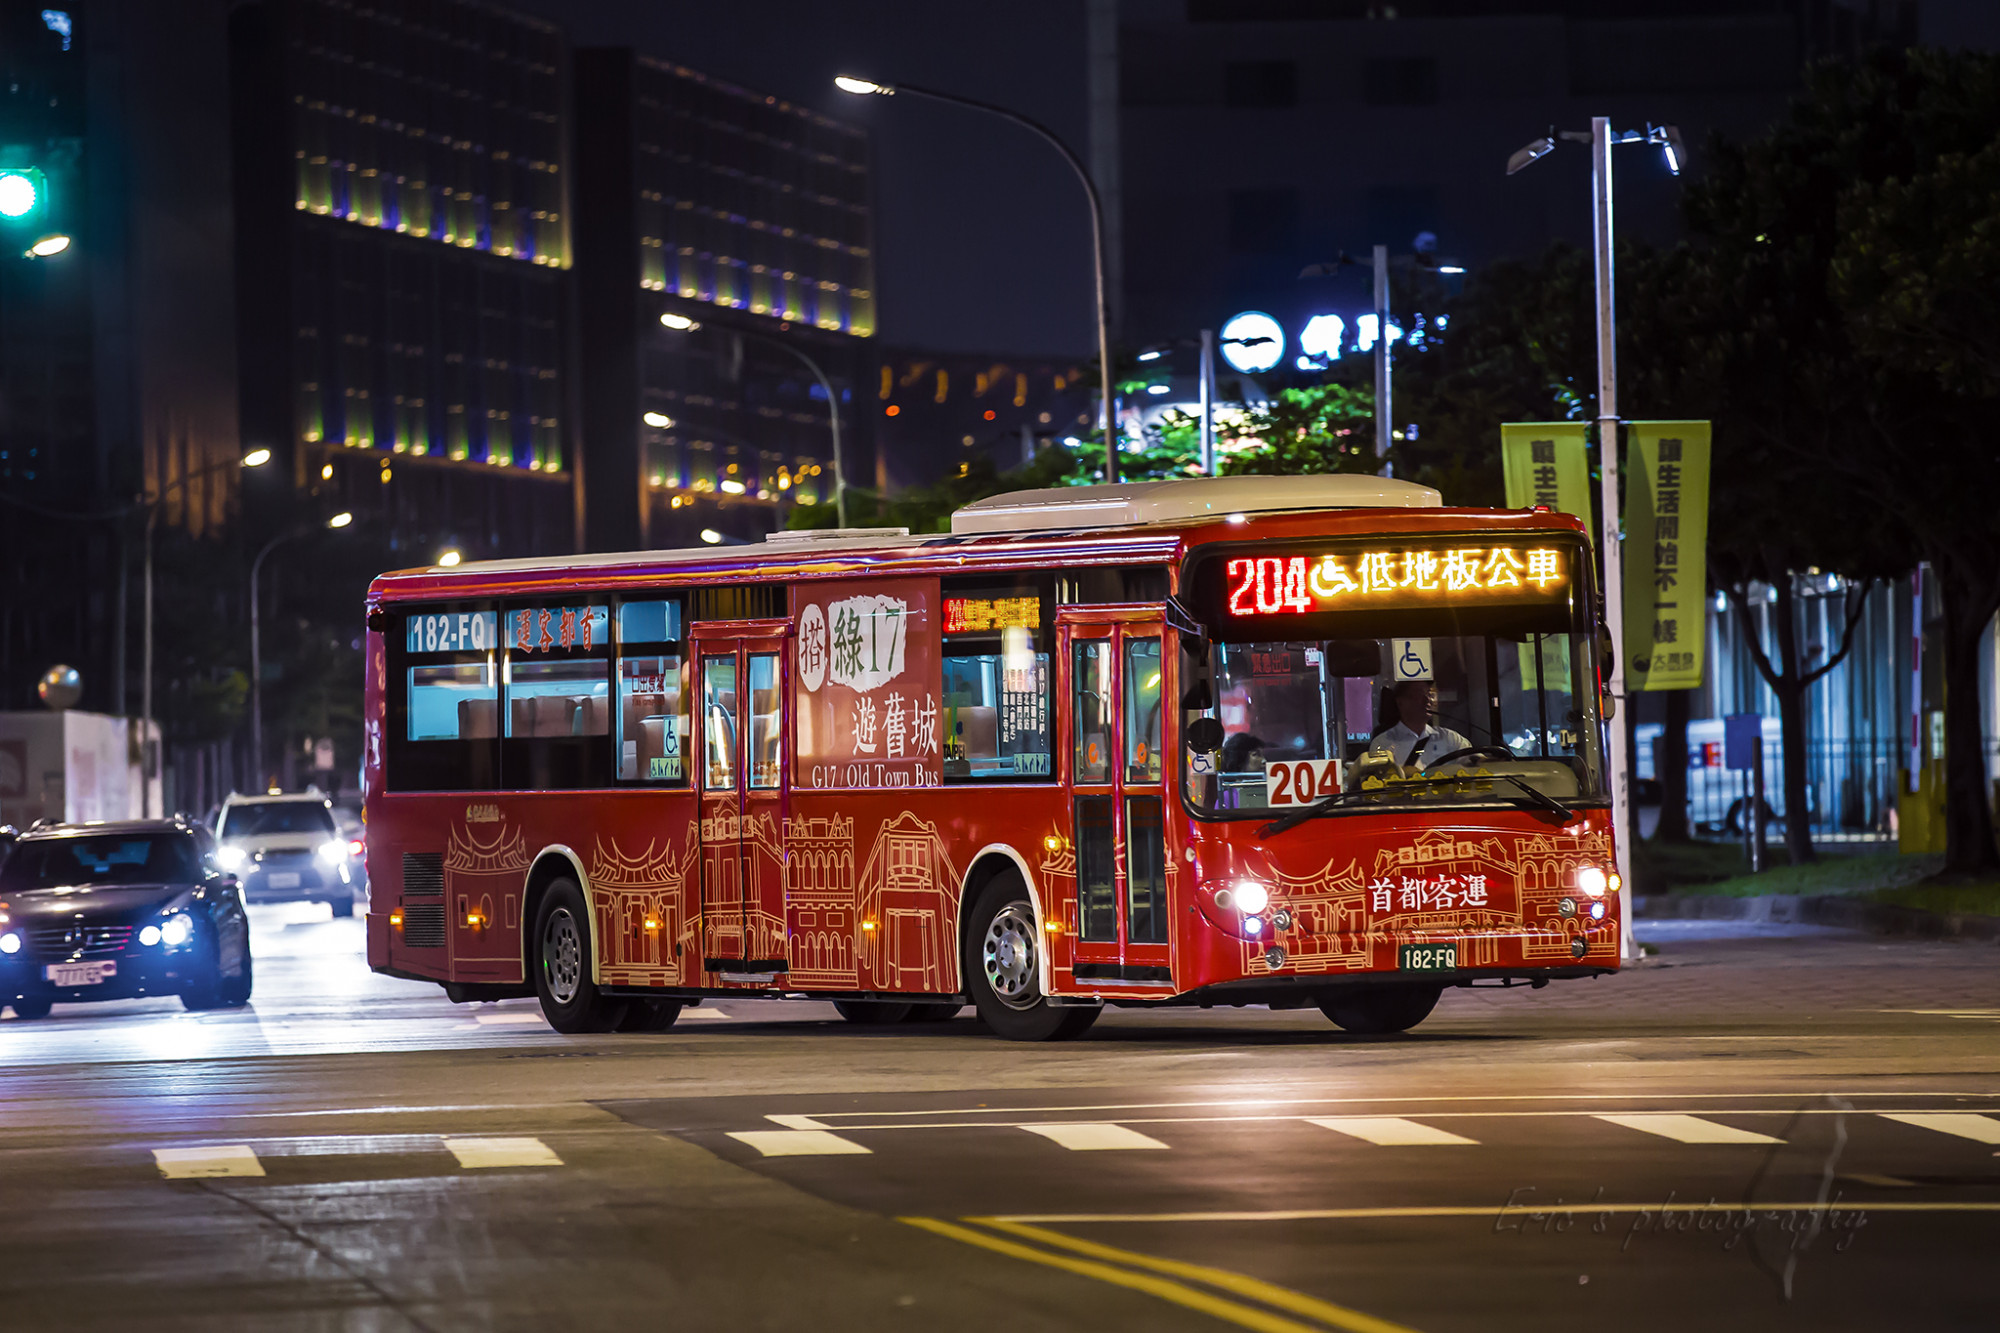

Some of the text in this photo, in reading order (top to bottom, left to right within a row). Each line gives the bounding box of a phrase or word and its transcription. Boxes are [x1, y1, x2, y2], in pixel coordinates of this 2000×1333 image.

[1227, 548, 1560, 615] 204 低地板公車
[413, 612, 486, 652] 182-FQ
[800, 617, 824, 675] 搭
[833, 606, 901, 680] 綠17
[1251, 653, 1291, 673] 緊急出口
[851, 691, 938, 759] 遊舊城
[811, 765, 837, 788] G17
[846, 764, 870, 788] Old
[874, 764, 910, 788] Town
[914, 763, 939, 788] Bus
[1269, 760, 1341, 805] 204
[1367, 873, 1489, 913] 首都客運
[1404, 948, 1456, 969] 182-FQ
